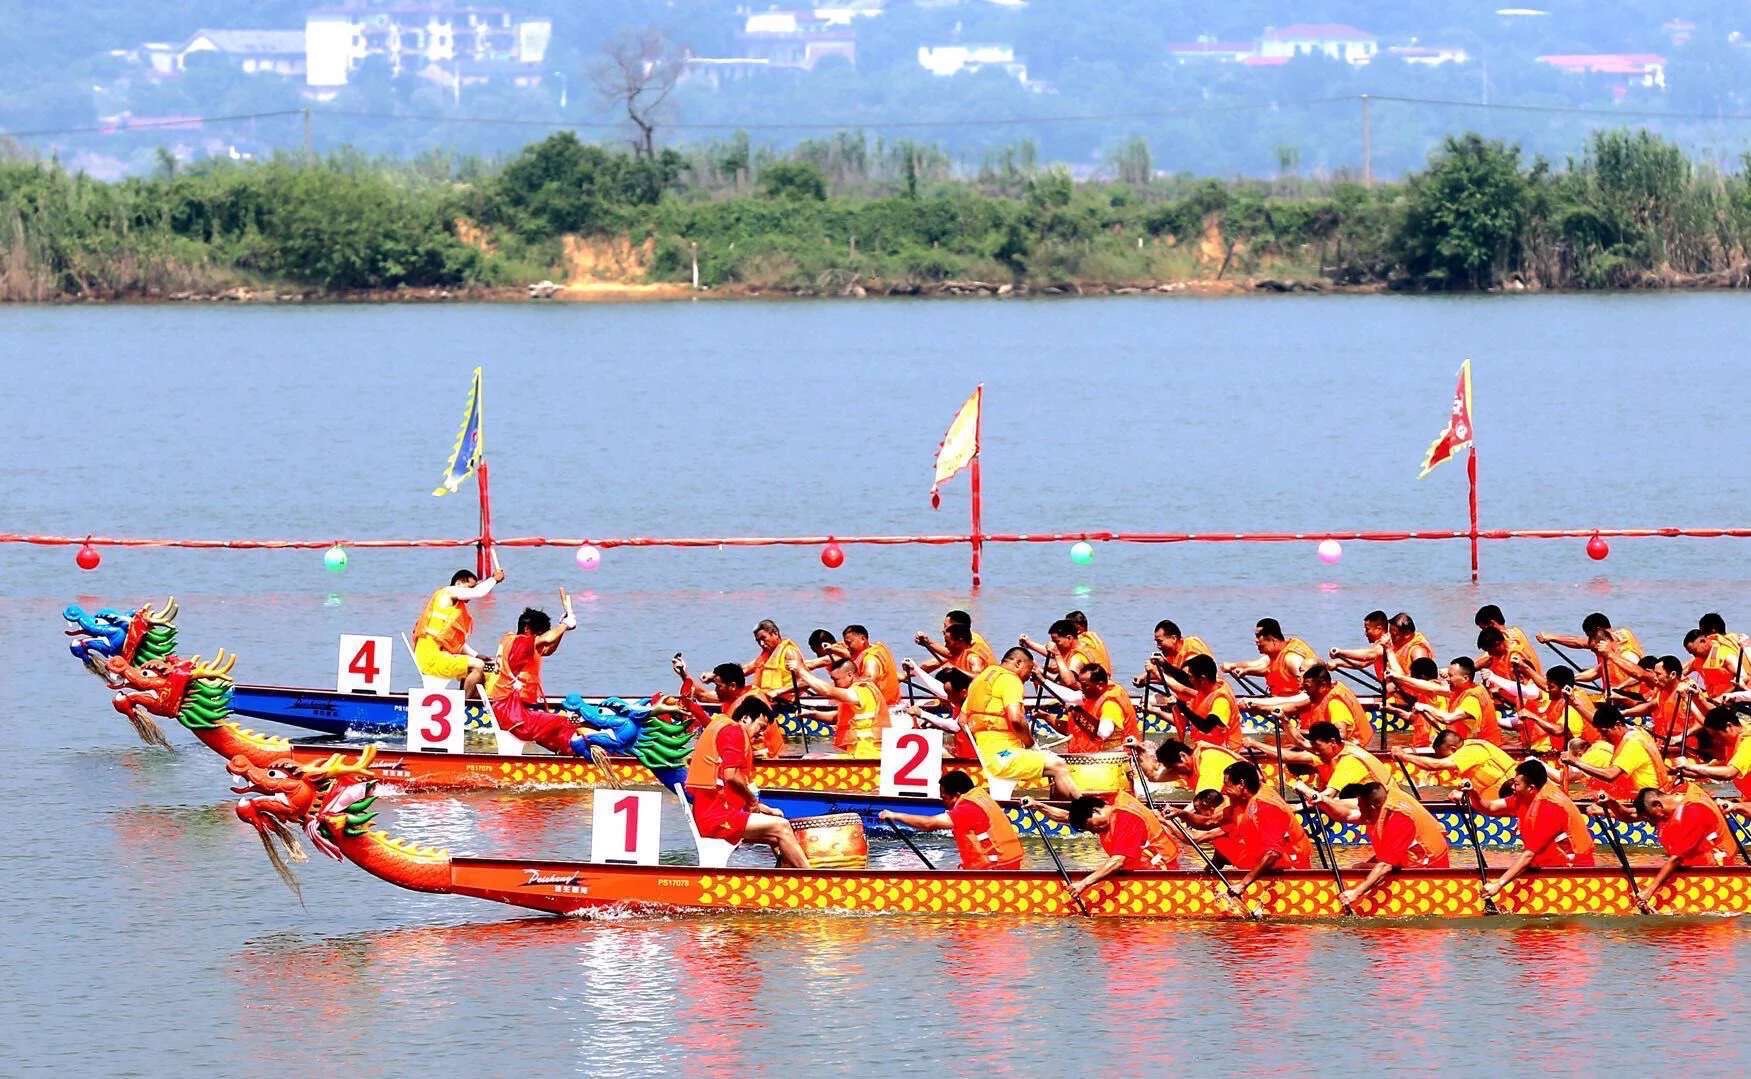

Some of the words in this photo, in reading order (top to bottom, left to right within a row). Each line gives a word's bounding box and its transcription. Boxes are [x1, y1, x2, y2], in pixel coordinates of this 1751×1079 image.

[348, 639, 380, 684] 4
[420, 693, 452, 743] 3
[893, 733, 930, 787] 2
[613, 795, 639, 853] 1
